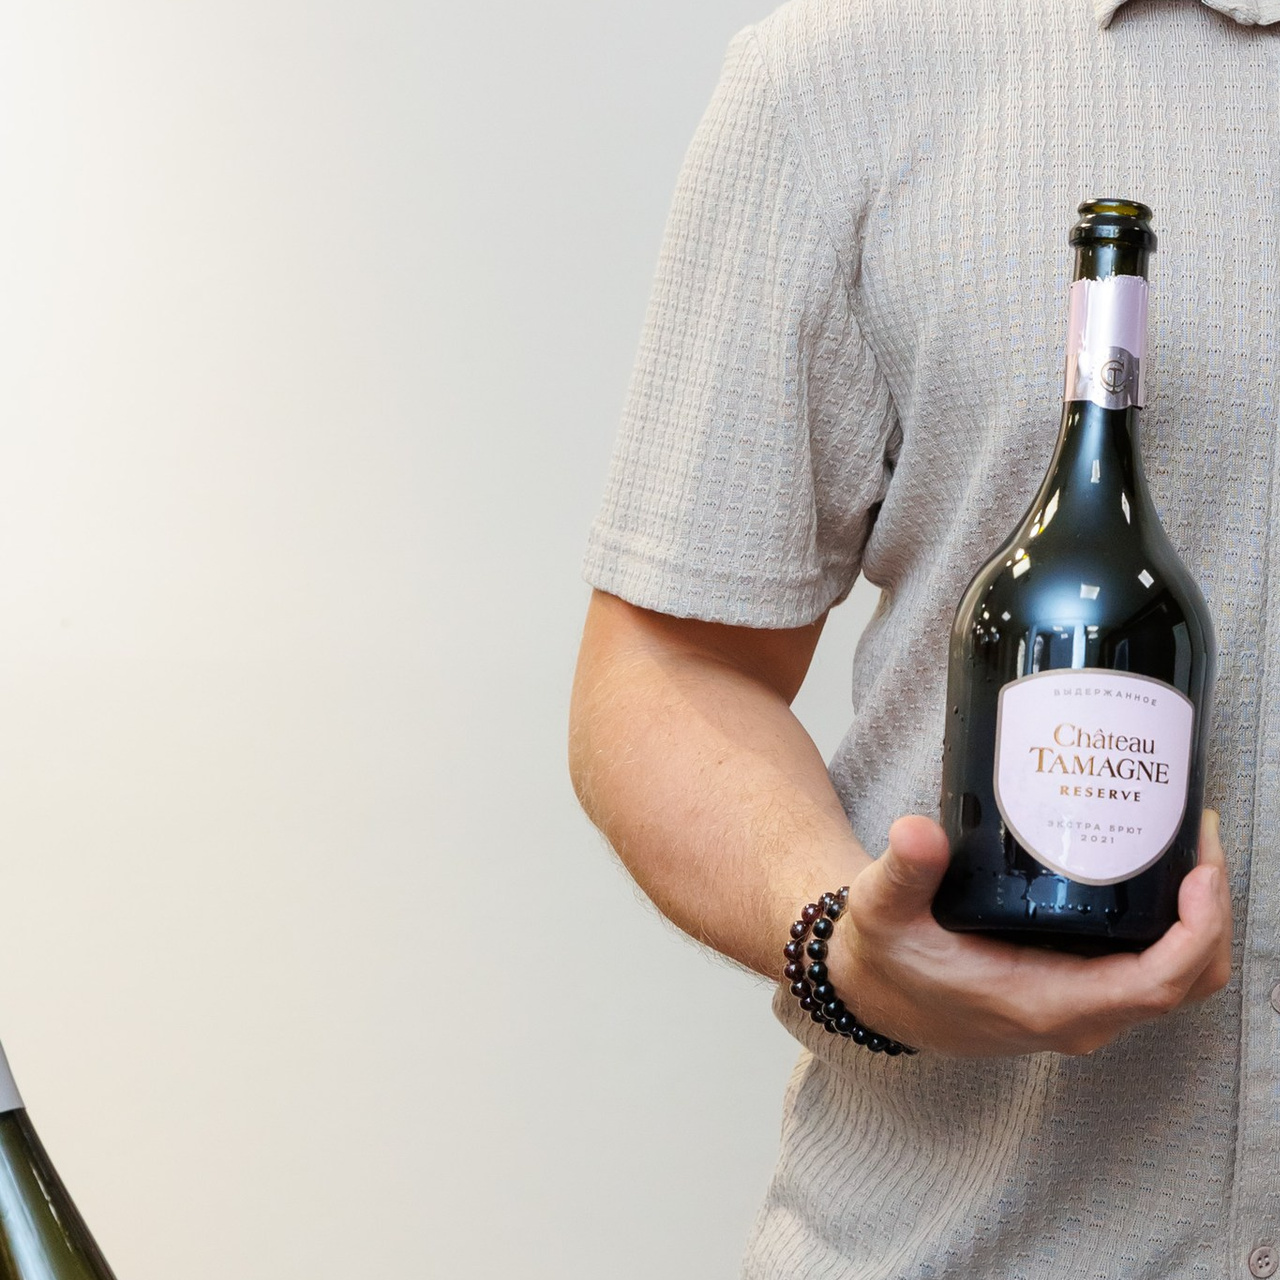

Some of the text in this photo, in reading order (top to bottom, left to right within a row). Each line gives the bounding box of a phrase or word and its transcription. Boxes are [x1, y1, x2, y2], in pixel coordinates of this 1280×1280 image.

[1053, 688, 1158, 707] ВЫДЕРЖАННОЕ
[1053, 722, 1156, 755] Château
[1029, 746, 1170, 785] TAMAGNE
[1059, 785, 1142, 802] RESERVE
[1047, 819, 1143, 836] ЭКСТРА БРЮТ
[1080, 833, 1115, 844] 2021
